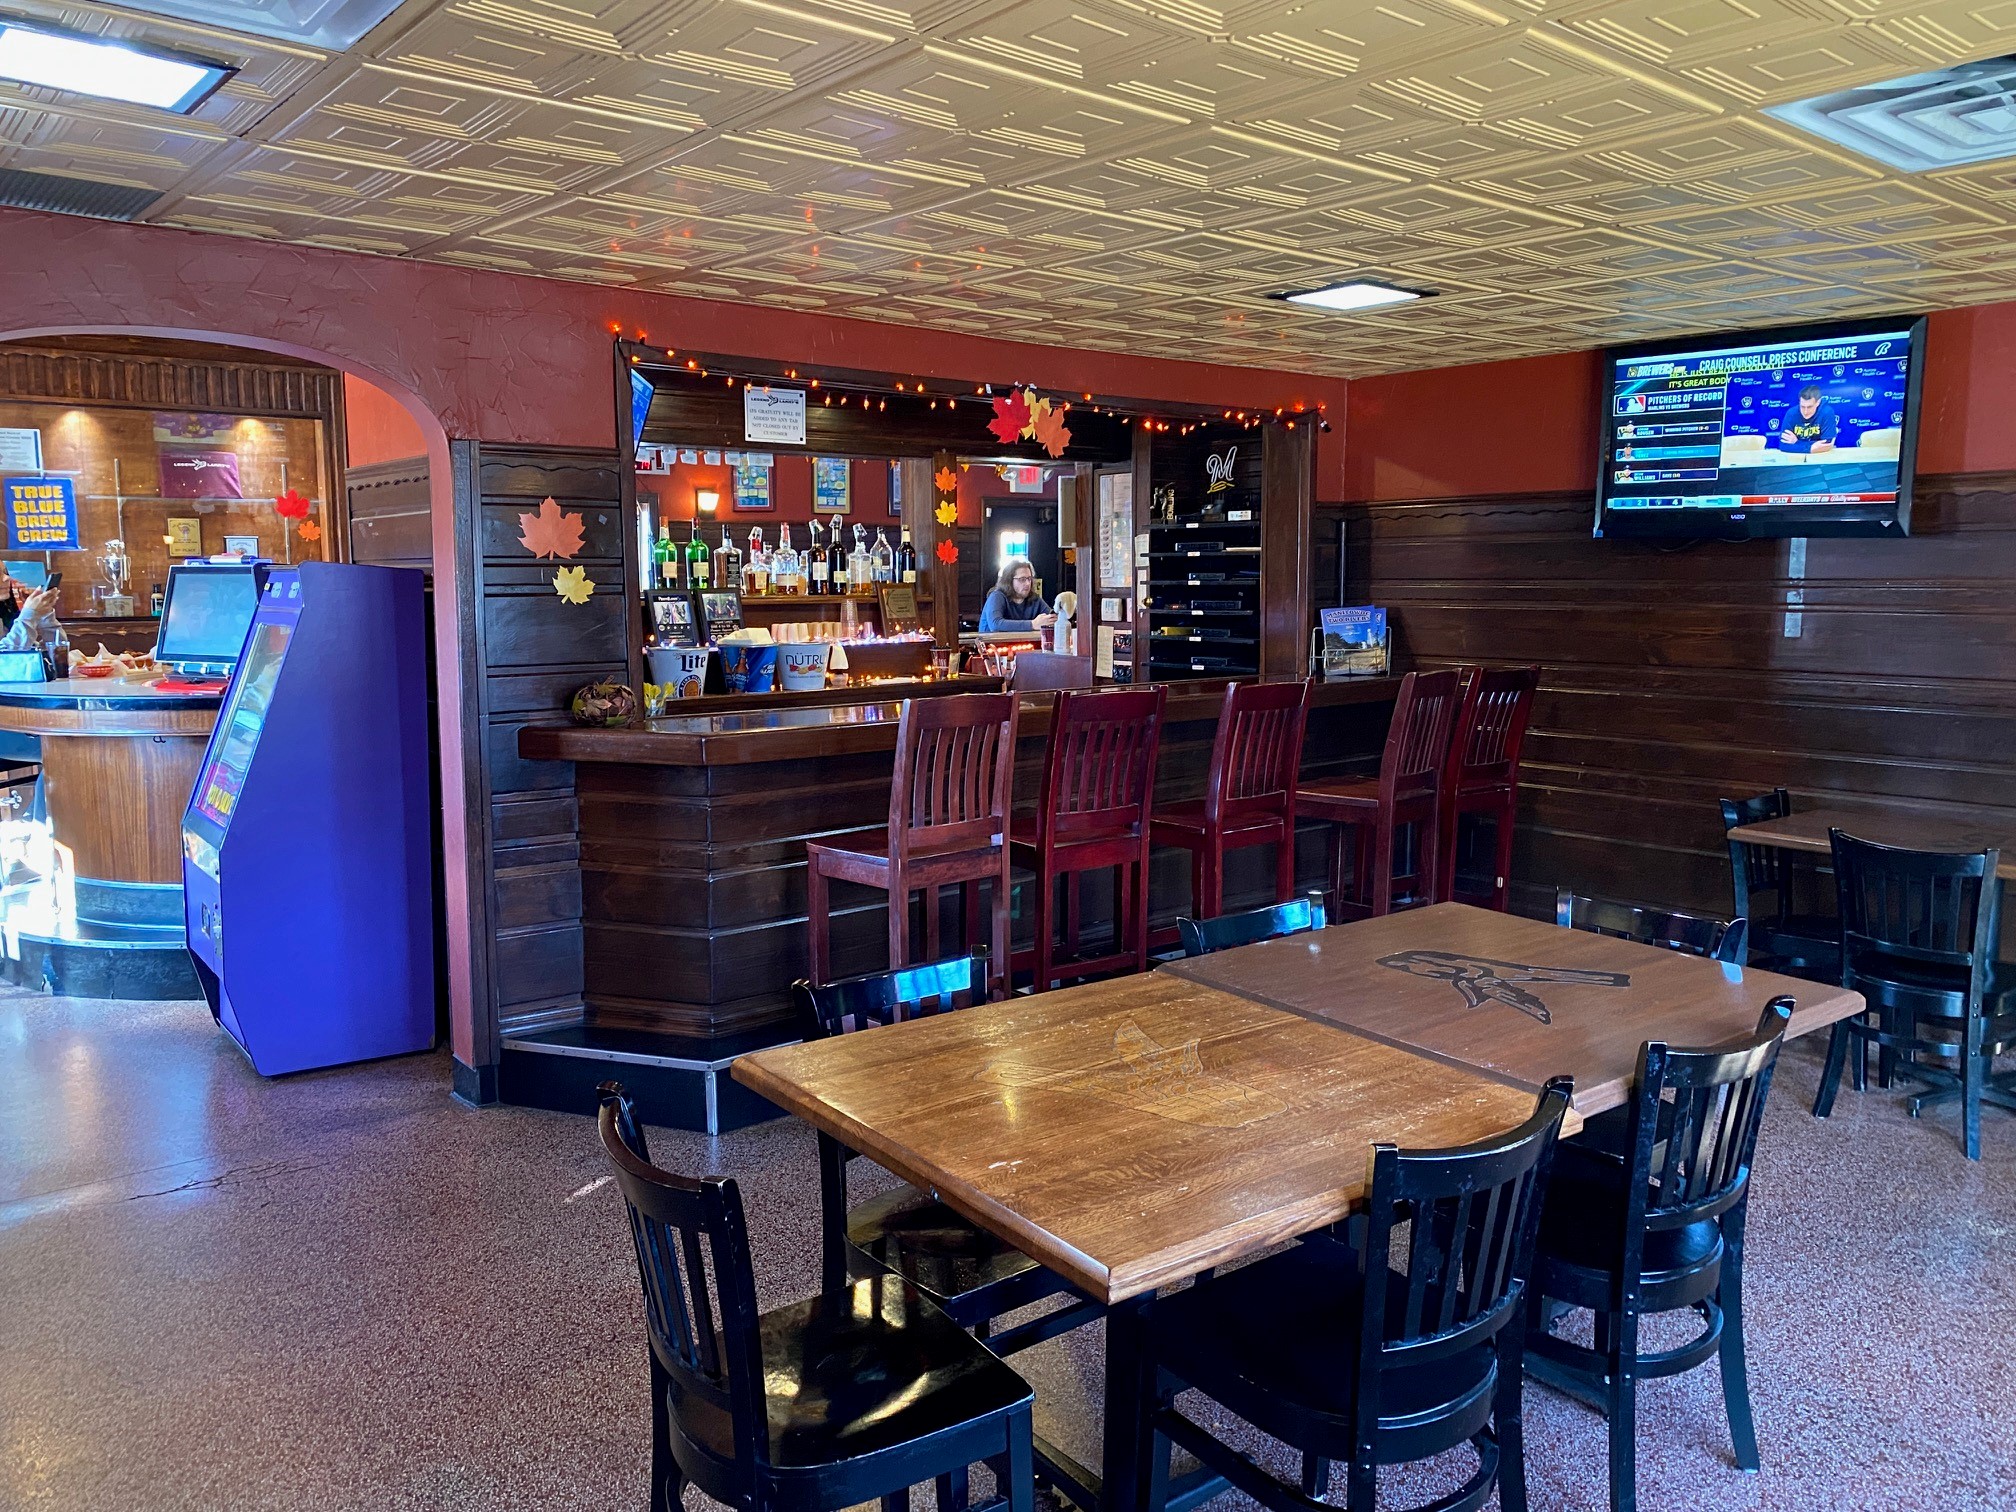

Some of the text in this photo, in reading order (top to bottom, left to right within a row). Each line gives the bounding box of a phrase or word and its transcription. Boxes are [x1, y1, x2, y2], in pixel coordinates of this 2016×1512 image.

[1700, 346, 1858, 371] CRAIG COUNSELL PRESS CONFERENCE
[1637, 363, 1675, 377] BREWERS
[1669, 376, 1732, 389] IT'S GREAT BODY
[1648, 391, 1723, 405] PITCHERS OF RECORD
[11, 485, 64, 499] TRUE
[13, 500, 66, 514] BLUE
[1672, 498, 1679, 506] 4
[15, 514, 67, 528] BREW
[17, 529, 68, 543] CREW
[1326, 610, 1371, 618] MANITOWOC
[680, 654, 706, 673] Lite
